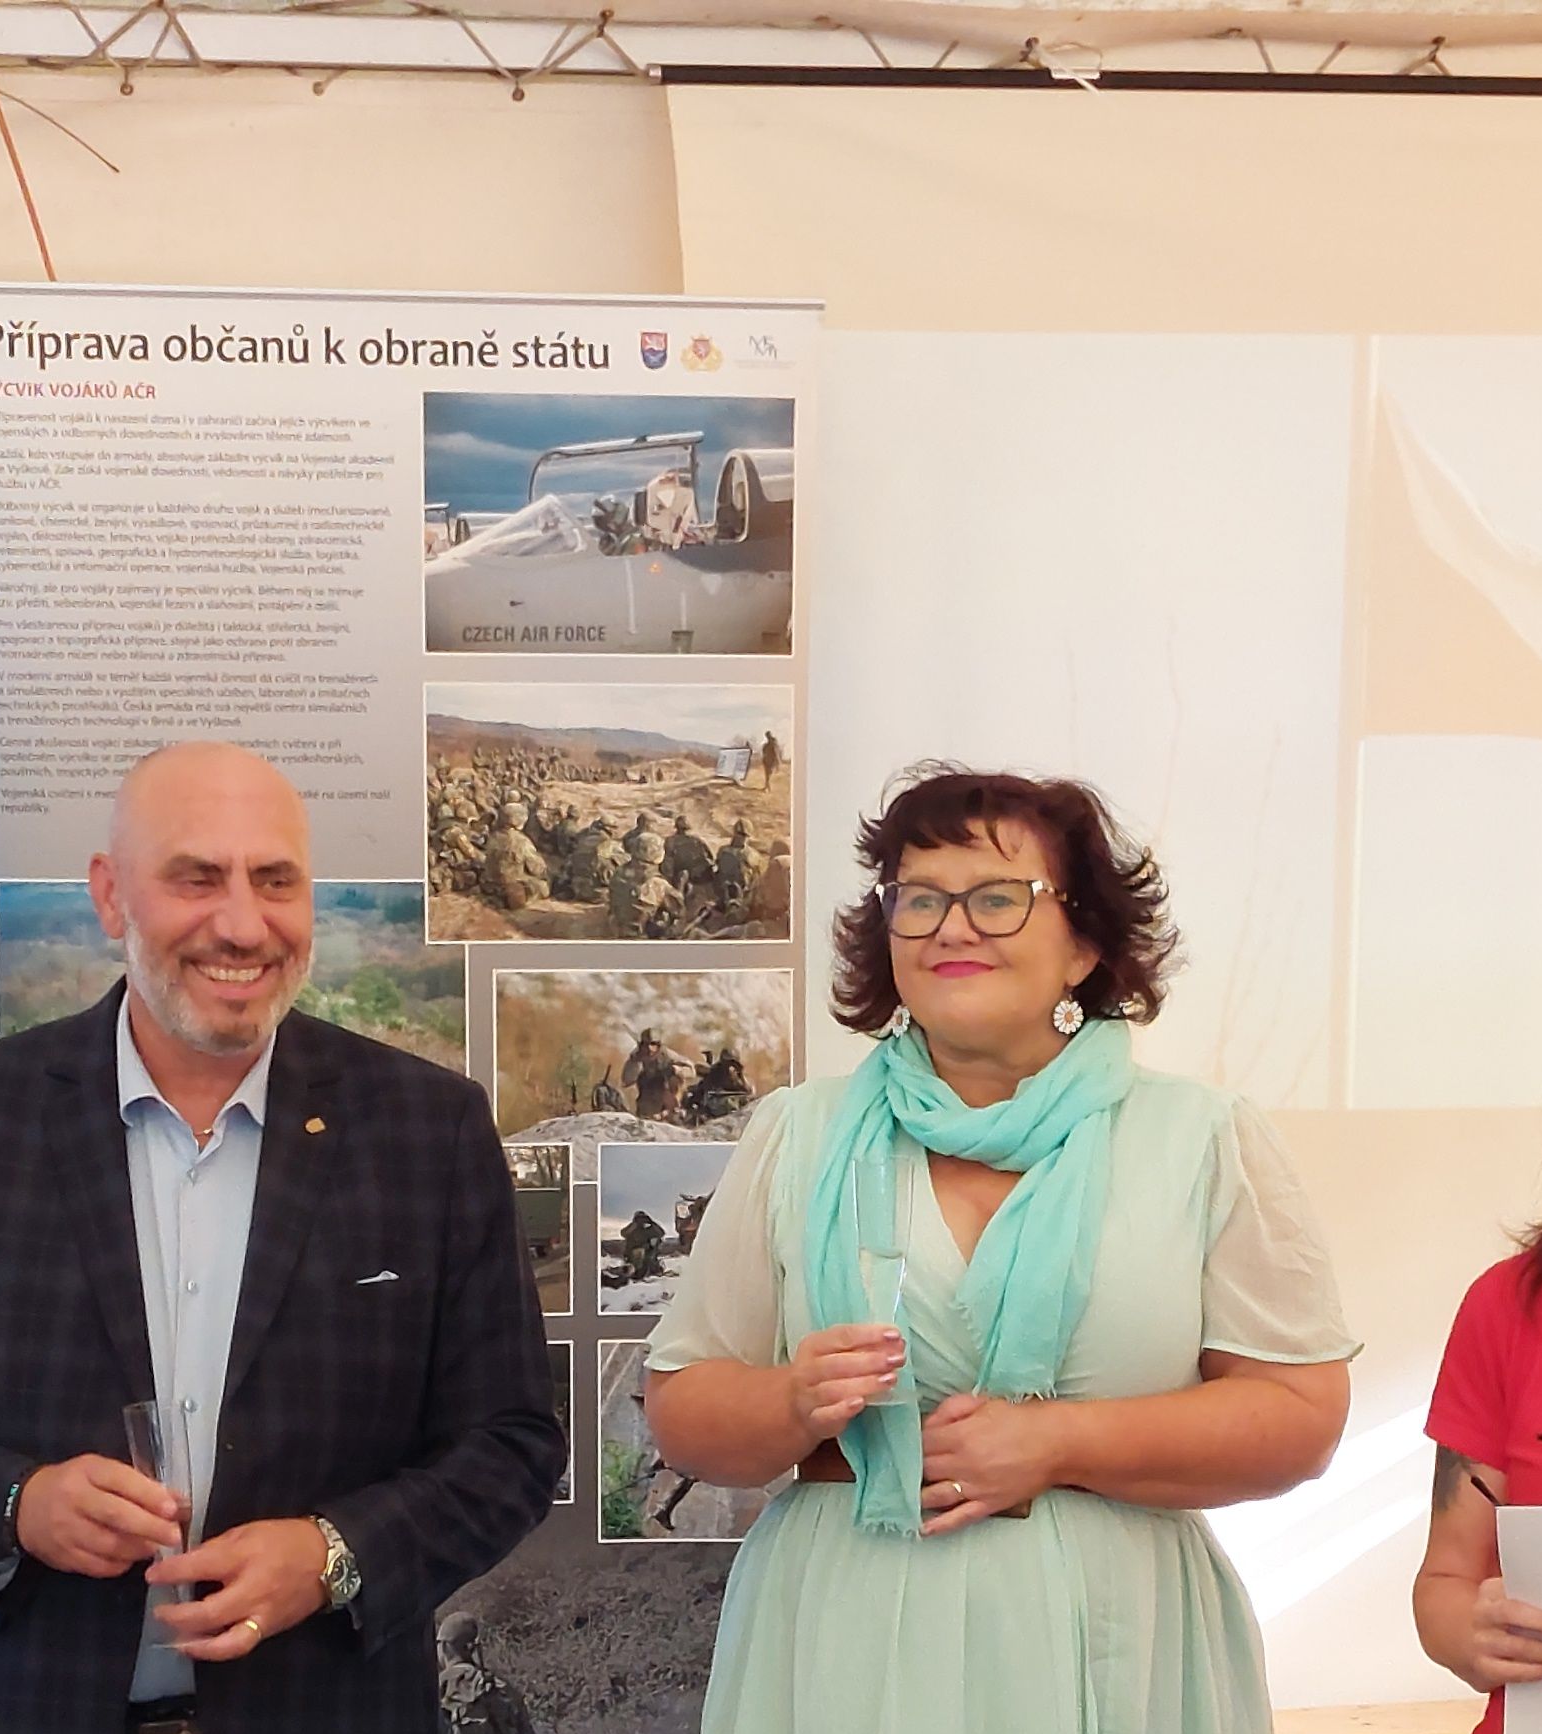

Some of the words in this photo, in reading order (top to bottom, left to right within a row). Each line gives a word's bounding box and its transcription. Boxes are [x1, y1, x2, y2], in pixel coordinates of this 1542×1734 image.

[163, 323, 309, 365] občanů
[323, 326, 345, 365] k
[358, 328, 499, 367] obraně
[511, 331, 610, 369] státu
[50, 380, 117, 400] VOJÁKŮ
[123, 381, 157, 400] AČR
[462, 625, 515, 643] CZECH
[520, 625, 550, 642] AIR
[554, 625, 607, 642] FORCE
